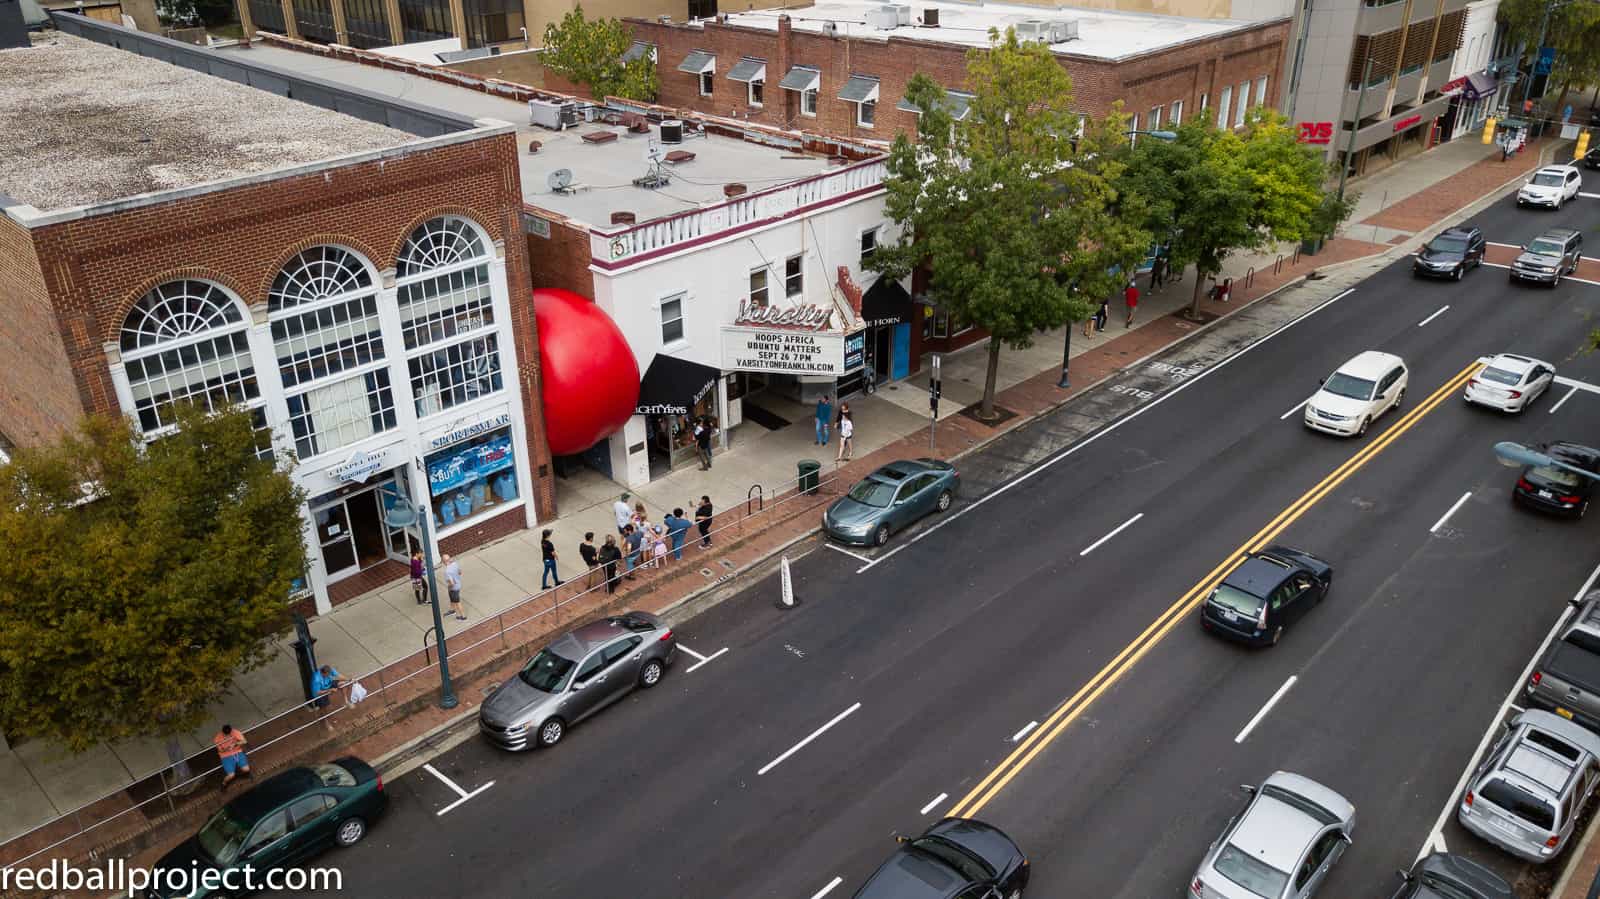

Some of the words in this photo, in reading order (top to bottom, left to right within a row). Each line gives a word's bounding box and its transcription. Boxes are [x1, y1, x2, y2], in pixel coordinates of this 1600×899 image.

[1296, 122, 1333, 137] CVS
[735, 298, 834, 331] Varsity
[874, 316, 900, 326] HORN
[755, 333, 782, 343] HOOPS
[785, 335, 815, 345] AFRICA
[747, 341, 780, 351] UBUNTU
[784, 344, 821, 354] MATTERS
[758, 351, 778, 360] SEPT
[780, 353, 790, 361] 26
[736, 359, 834, 372] VARSITYONFRANKLIN.COM
[1109, 384, 1155, 400] BUS
[432, 414, 510, 447] SPORTSWEAR
[485, 448, 505, 464] FREE
